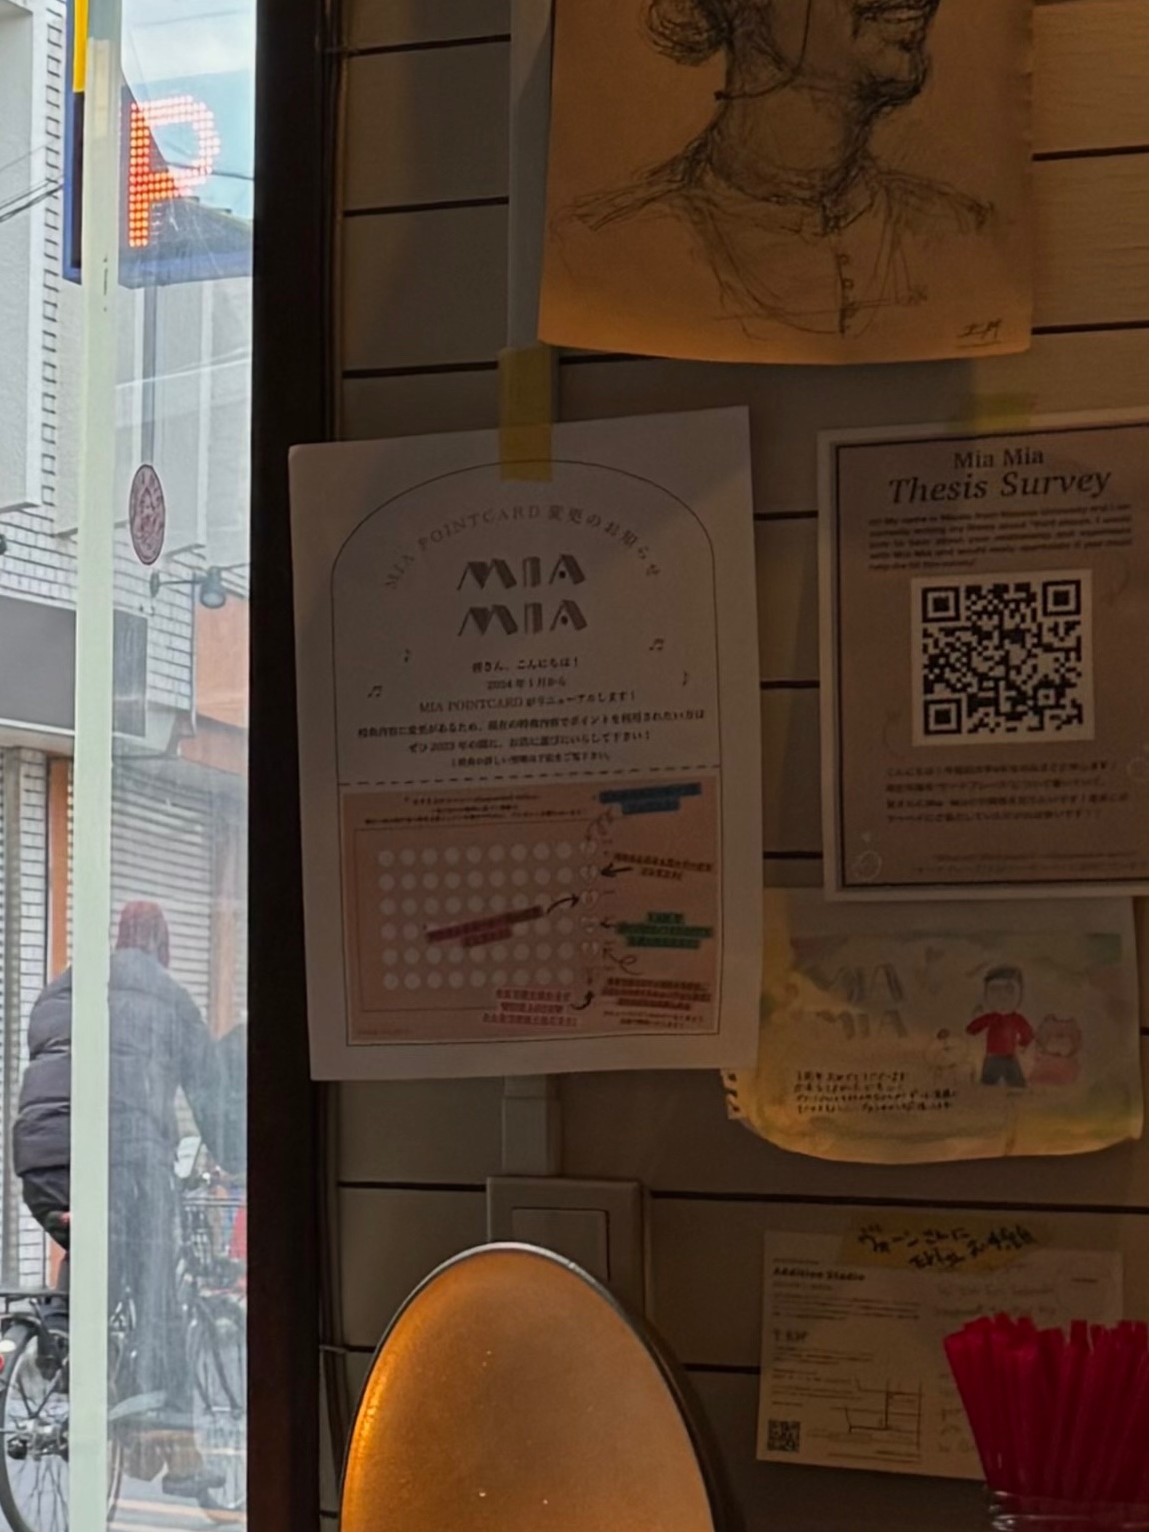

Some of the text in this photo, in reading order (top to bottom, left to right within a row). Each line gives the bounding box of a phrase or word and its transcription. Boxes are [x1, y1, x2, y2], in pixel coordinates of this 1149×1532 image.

[129, 94, 222, 248] P
[954, 448, 1045, 469] Mia Mia
[889, 471, 1112, 503] Thesis Survey
[383, 504, 663, 592] MIA POINTCARD 変更のお知らせ
[457, 554, 587, 592] MIA
[457, 598, 589, 637] MIA
